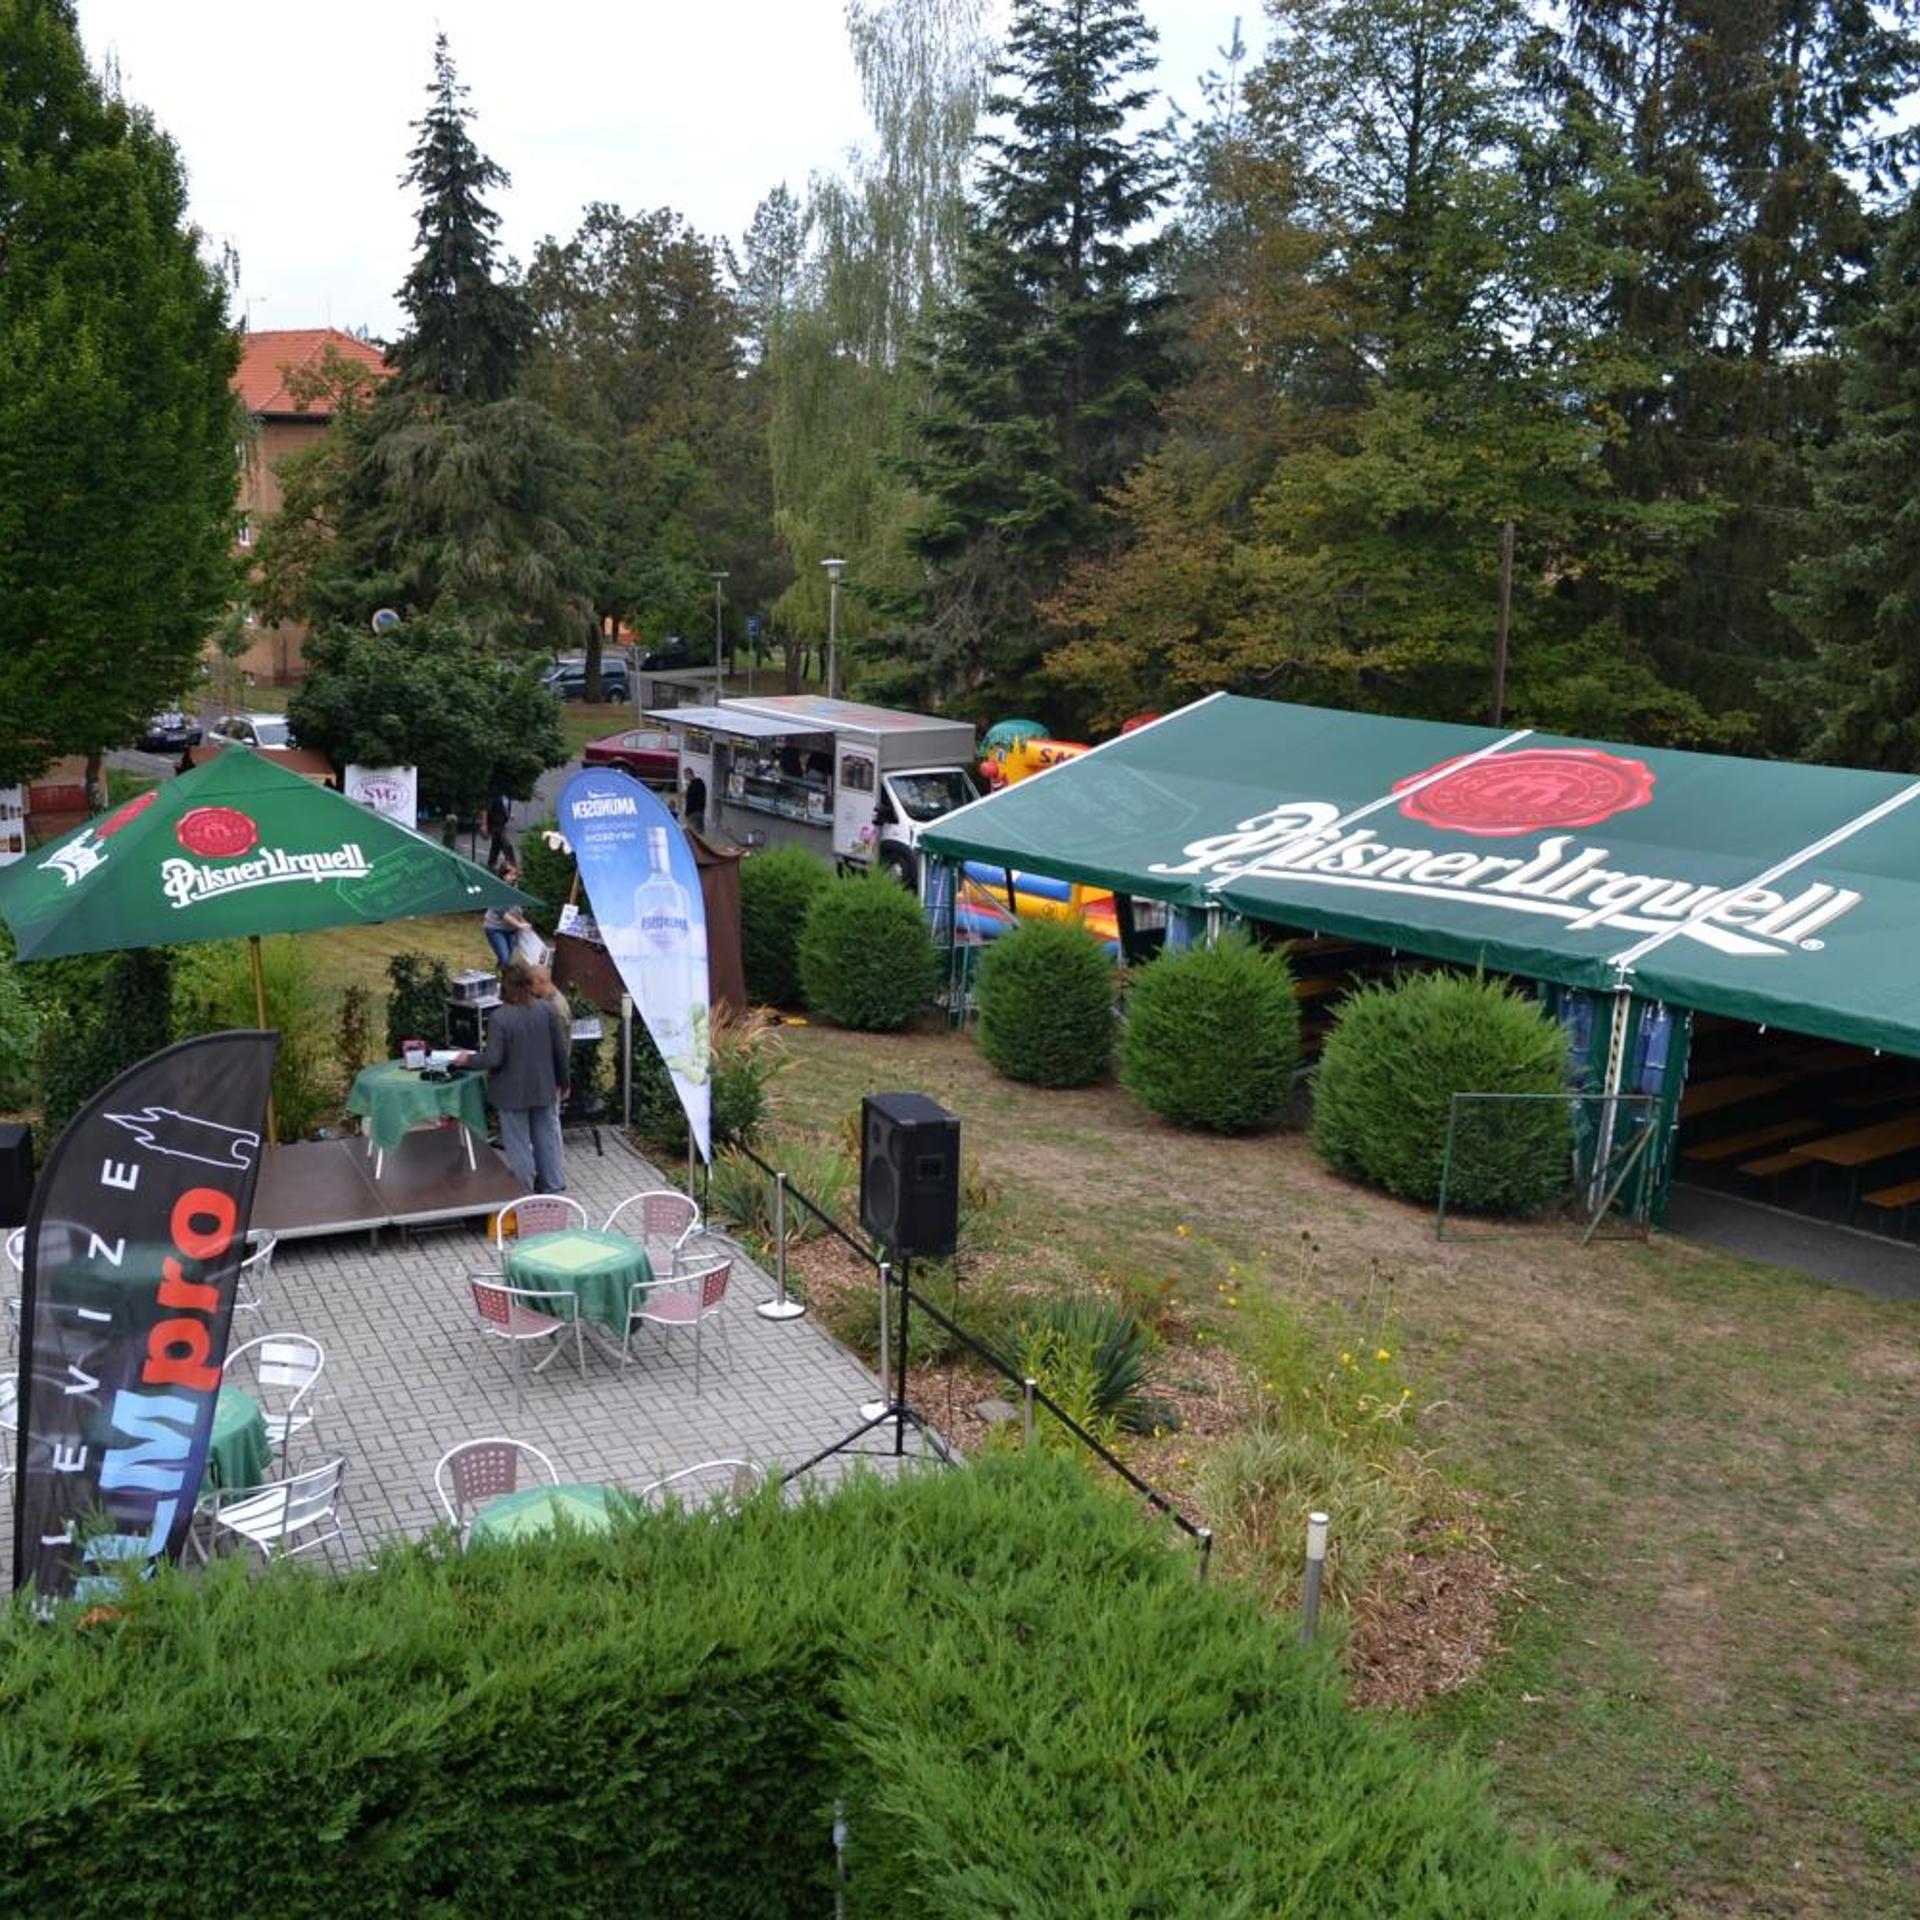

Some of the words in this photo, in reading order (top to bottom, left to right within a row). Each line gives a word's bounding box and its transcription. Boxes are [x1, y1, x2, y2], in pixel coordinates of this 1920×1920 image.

[161, 858, 269, 908] Pilsner
[259, 844, 366, 882] Urquell
[1148, 801, 1524, 891] Pilsner
[1481, 835, 1863, 944] Urquell
